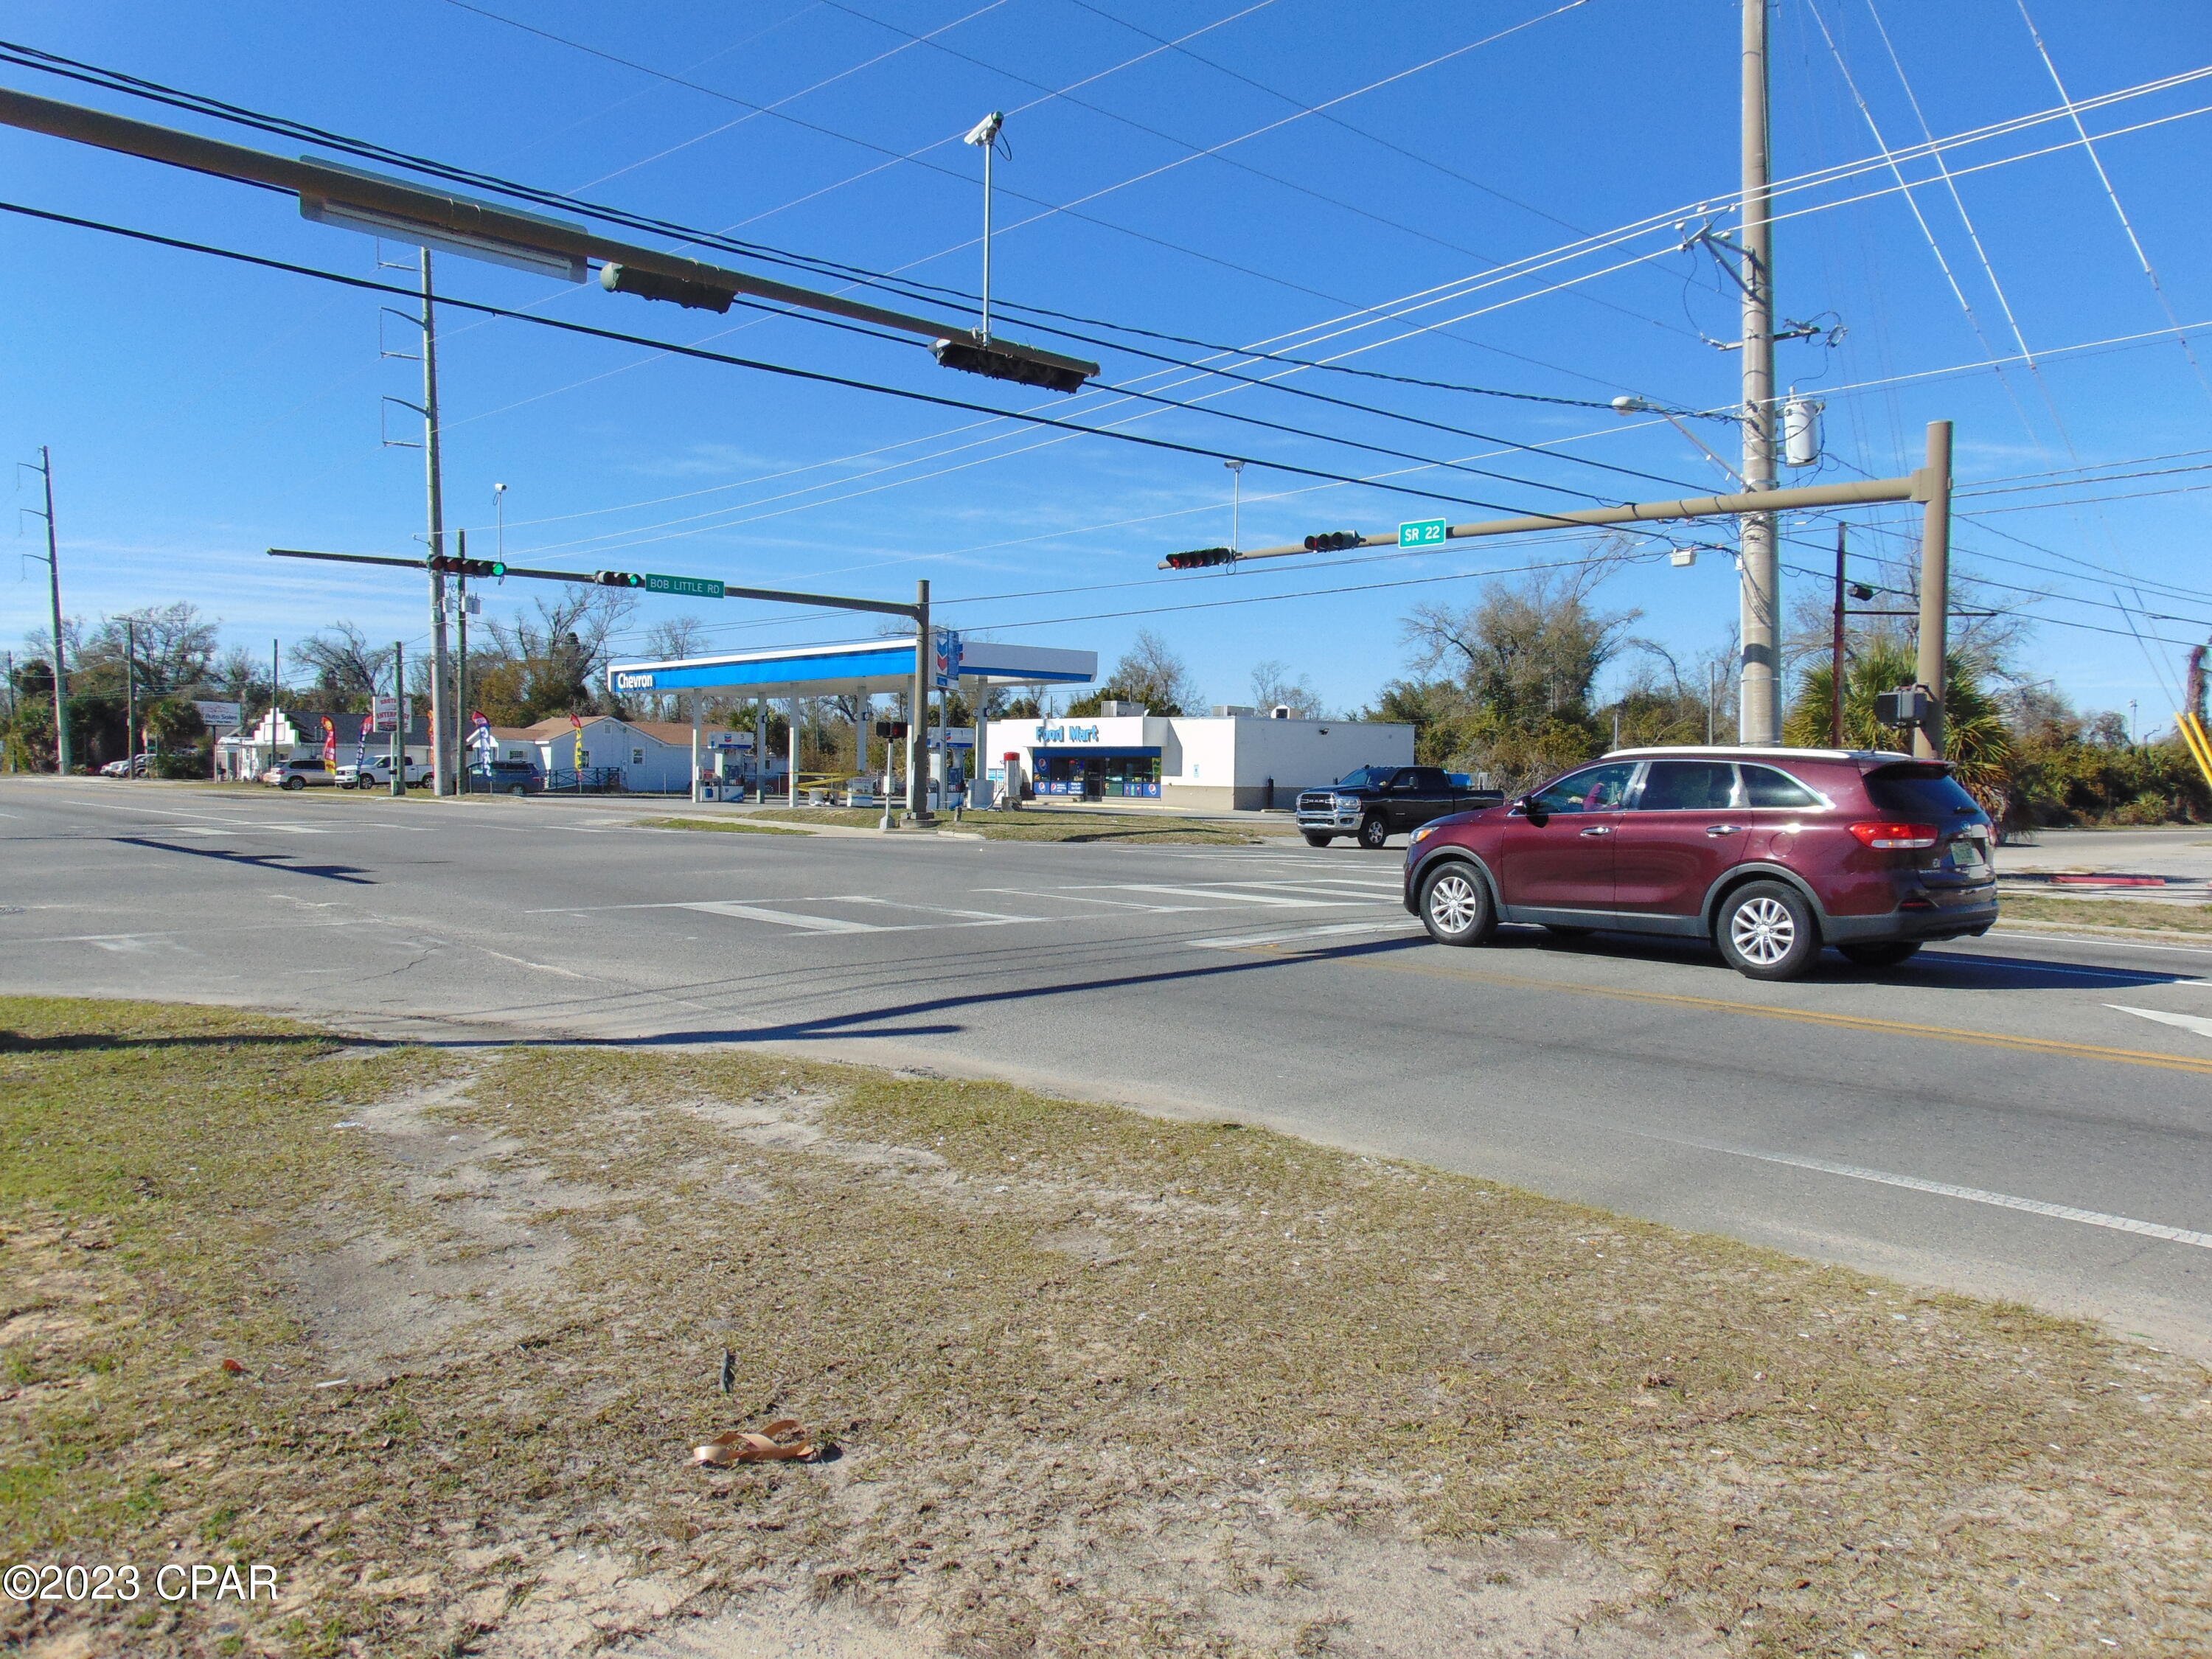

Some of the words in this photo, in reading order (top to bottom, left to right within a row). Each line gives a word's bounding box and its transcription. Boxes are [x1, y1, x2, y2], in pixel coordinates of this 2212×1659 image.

[1405, 528, 1419, 542] SR
[1425, 525, 1440, 540] 22
[650, 578, 669, 589] BOB
[674, 580, 703, 592] LITTLE
[708, 584, 720, 594] RD
[618, 672, 653, 689] Chevron
[1036, 725, 1063, 741] Food
[1069, 725, 1098, 741] Mart
